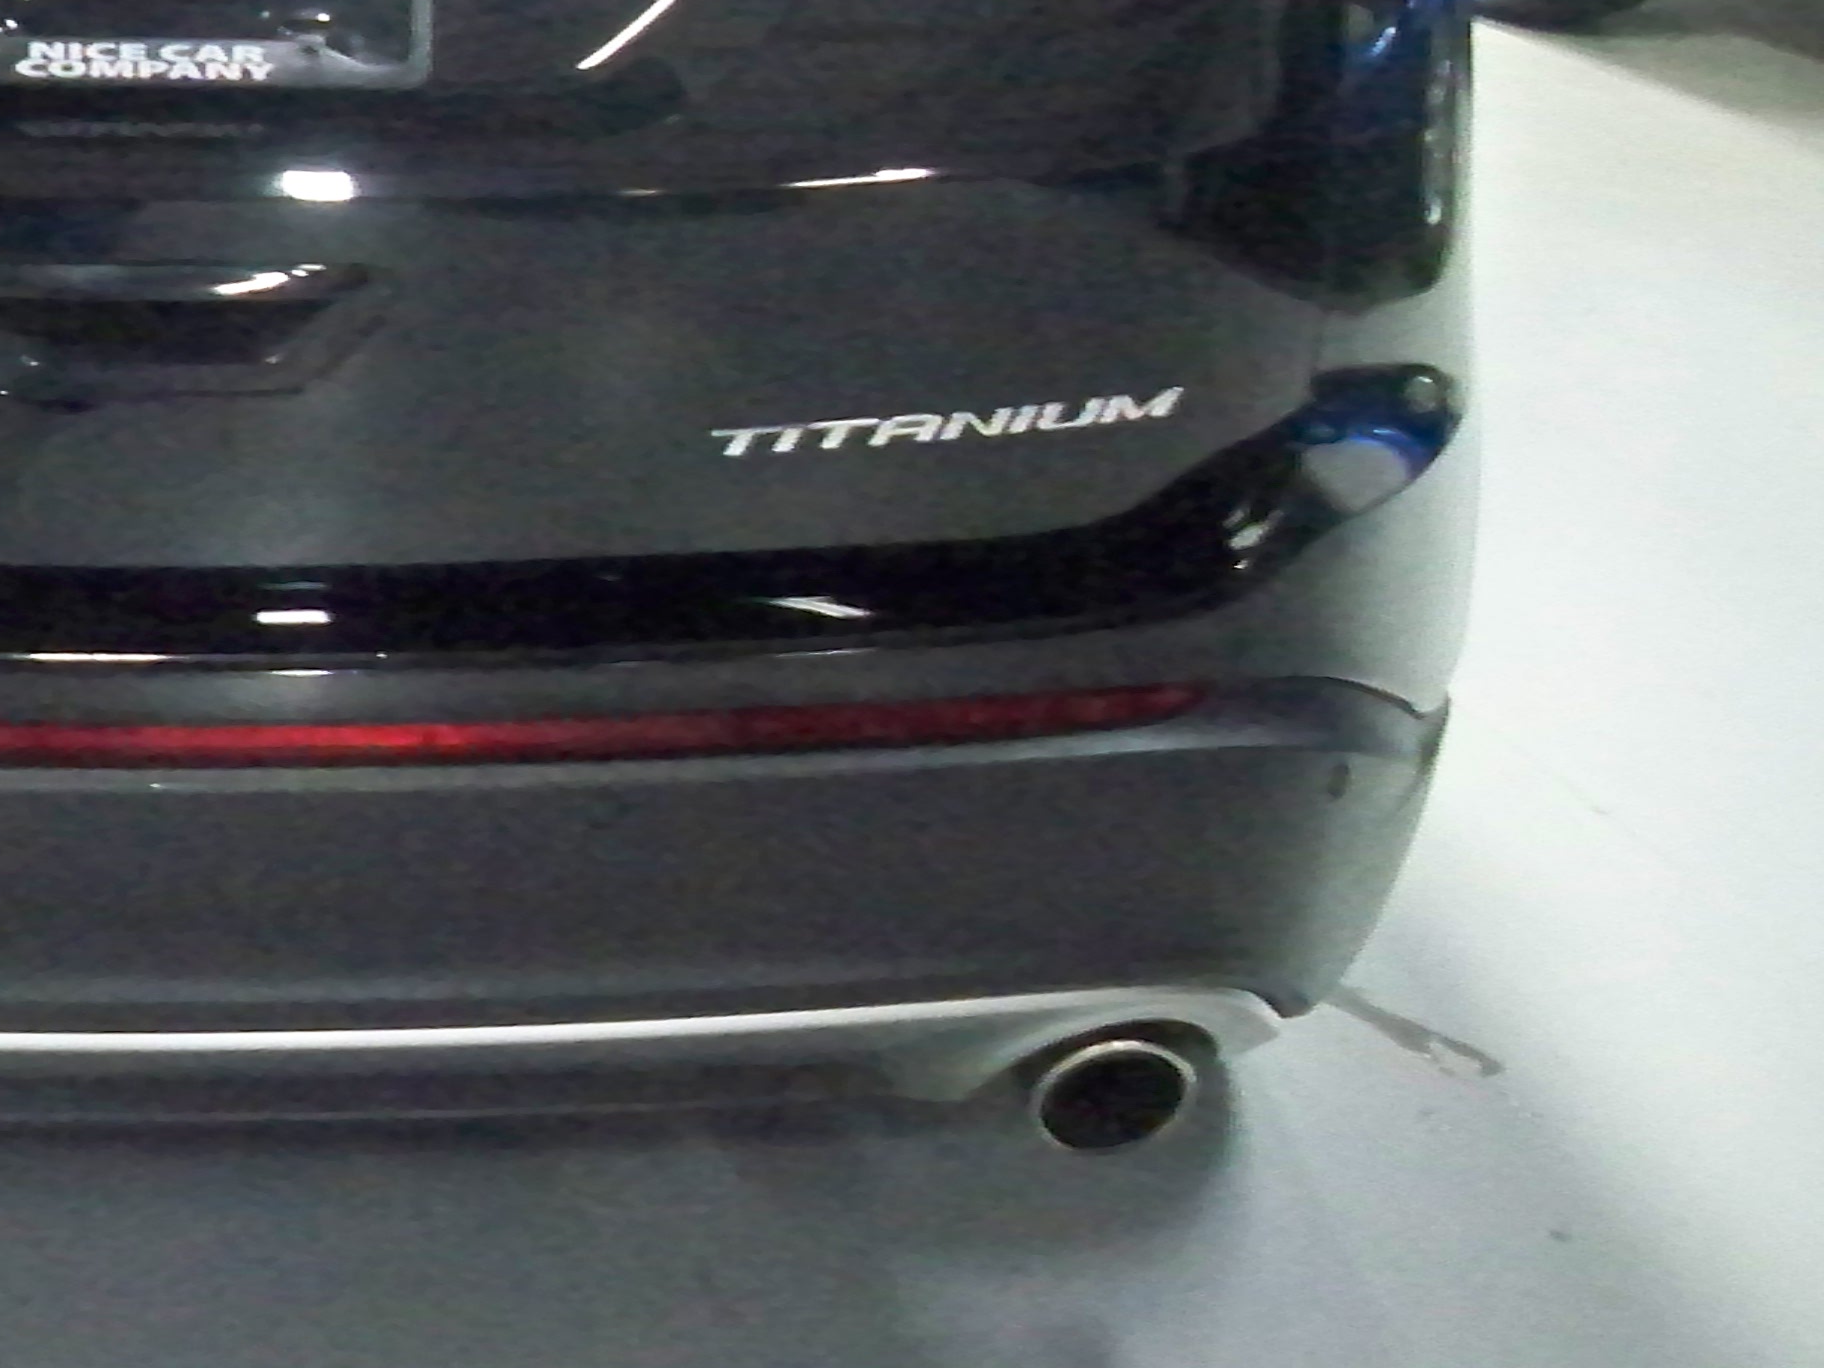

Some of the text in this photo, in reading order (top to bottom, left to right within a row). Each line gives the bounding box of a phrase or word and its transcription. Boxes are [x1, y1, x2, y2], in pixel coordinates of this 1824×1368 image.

[26, 41, 265, 63] NICE CAR
[14, 58, 274, 81] COMPANY
[710, 386, 1185, 457] TITANIUM
